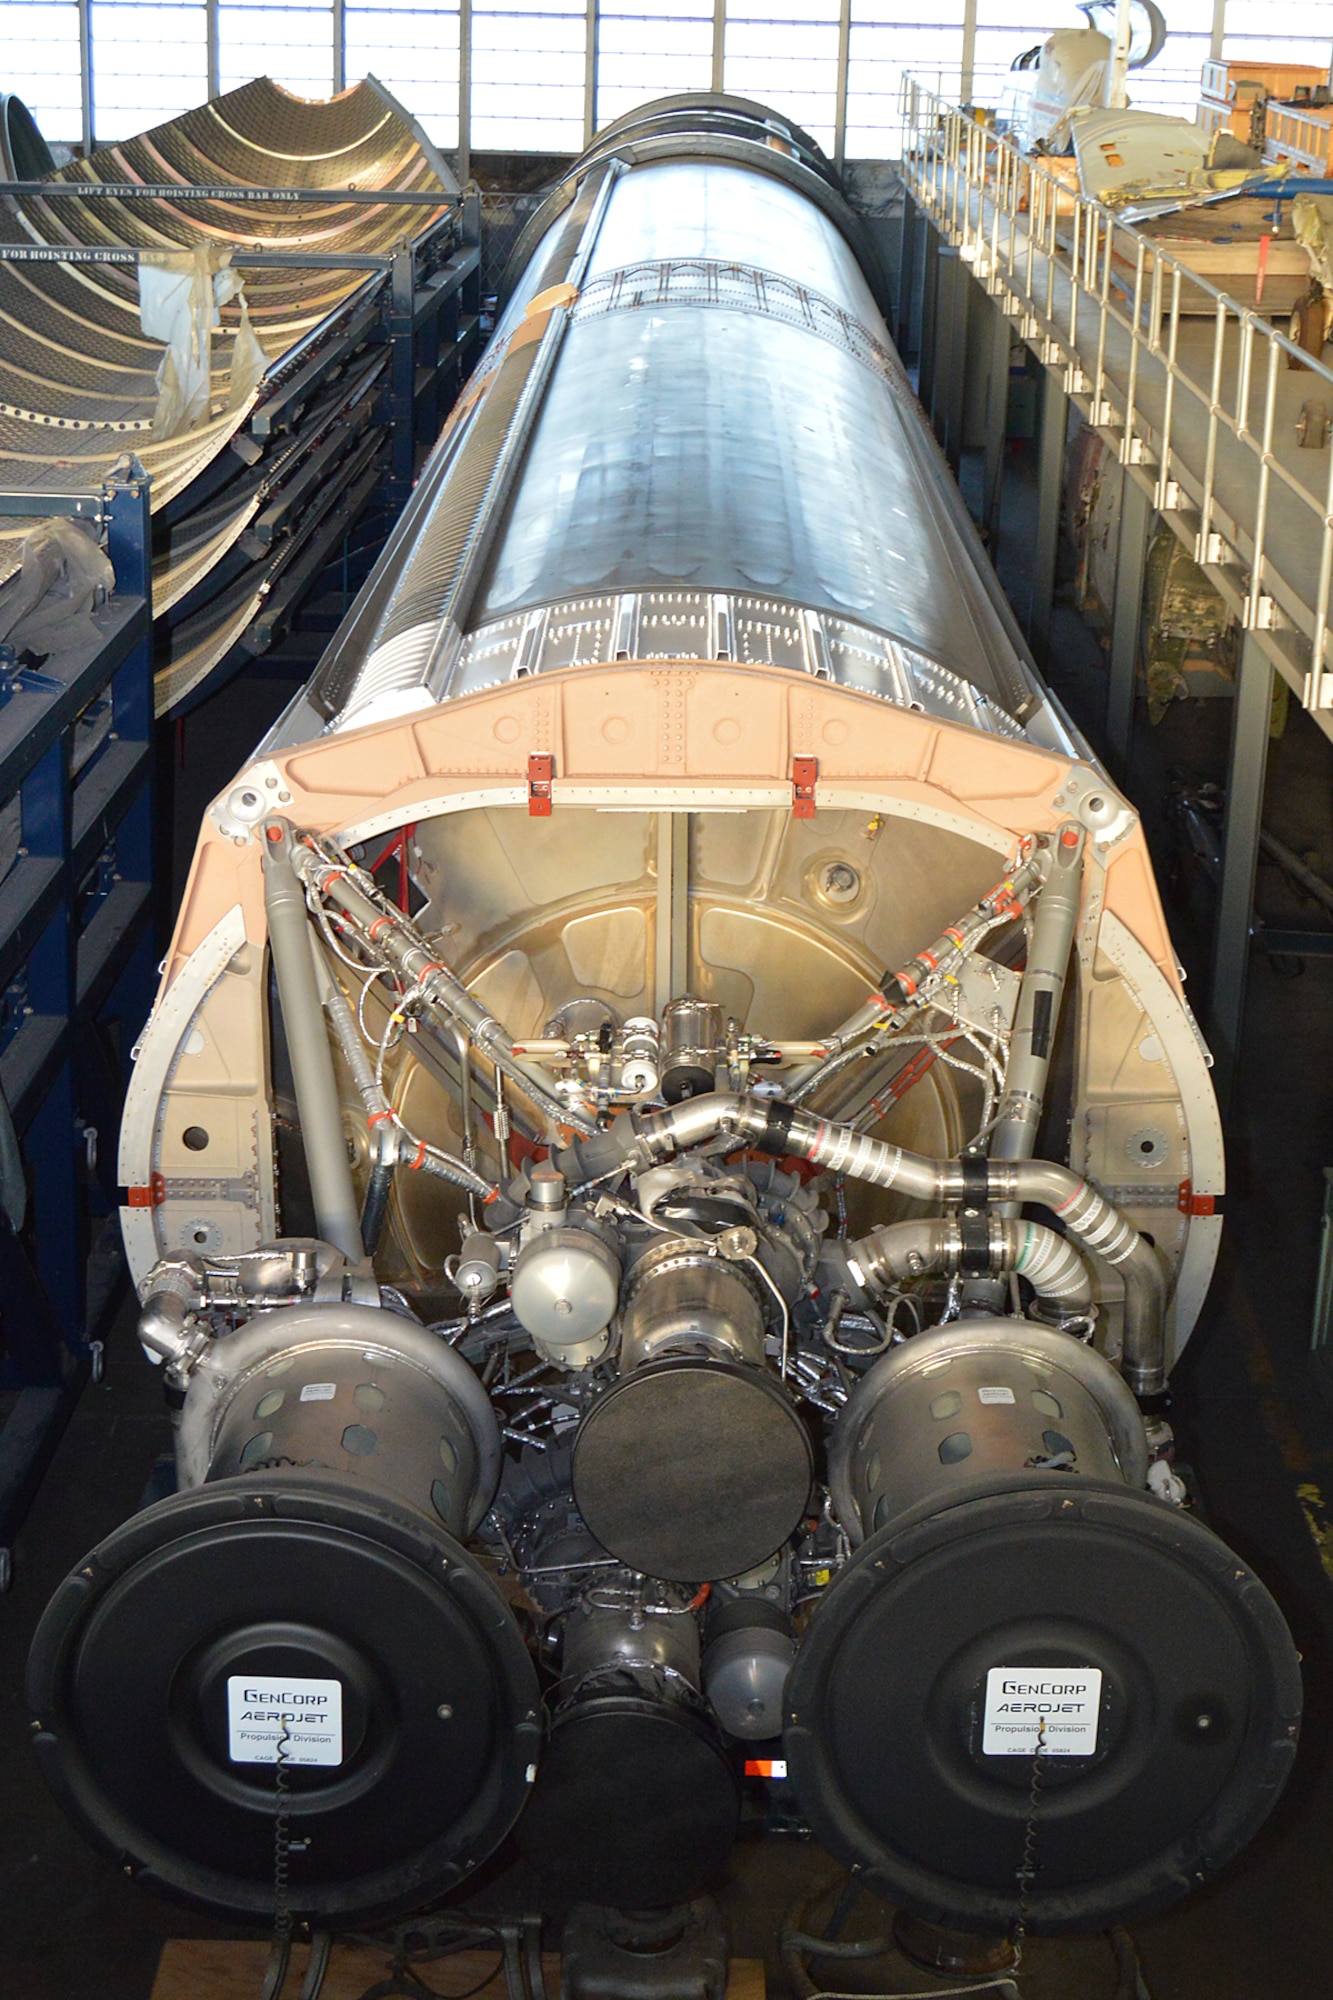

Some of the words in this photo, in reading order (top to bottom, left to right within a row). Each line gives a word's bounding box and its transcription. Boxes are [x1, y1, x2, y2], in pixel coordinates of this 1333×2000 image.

[78, 186, 103, 196] LIFT
[105, 187, 133, 196] EYES
[135, 188, 157, 197] FOR
[158, 188, 209, 198] HOISTING
[211, 190, 245, 199] CROSS
[248, 191, 270, 200] BAR
[273, 192, 300, 201] ONLY
[1, 249, 28, 259] FOR
[29, 250, 92, 260] HOISTING
[94, 251, 136, 262] CROSS
[1002, 1681, 1086, 1695] GENCORP
[244, 1689, 328, 1705] GENCORP
[996, 1703, 1085, 1713] AEROJET
[240, 1711, 328, 1723] AEROJET
[994, 1724, 1045, 1734] Propulsio
[1048, 1725, 1087, 1733] Division
[293, 1734, 332, 1744] Division
